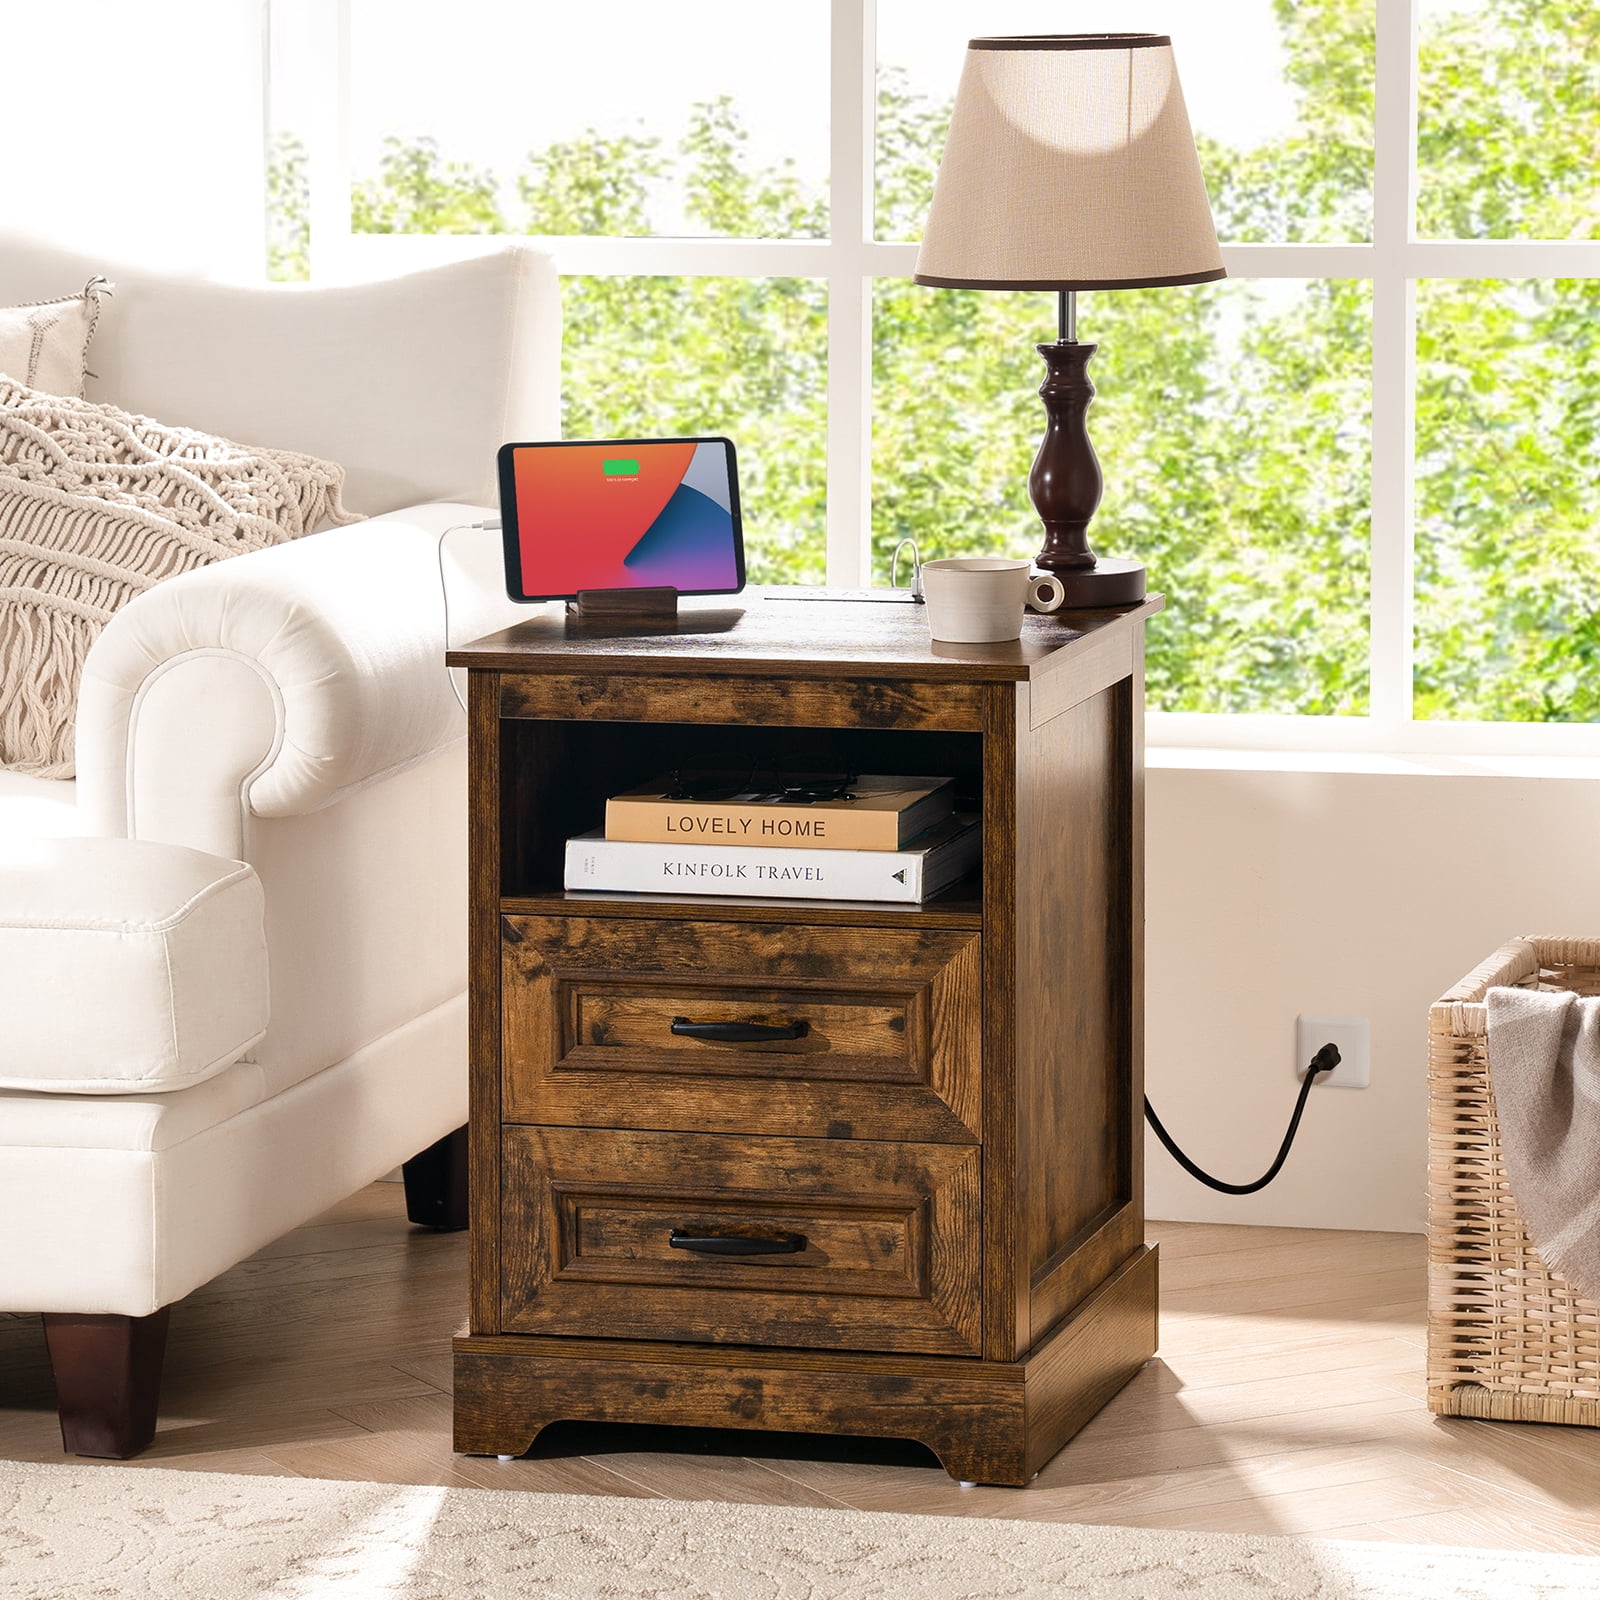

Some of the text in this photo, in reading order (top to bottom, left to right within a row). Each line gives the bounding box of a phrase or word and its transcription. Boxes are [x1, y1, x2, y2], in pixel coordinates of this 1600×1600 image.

[666, 815, 826, 837] LOVELY HOME
[663, 862, 824, 881] KINFOLK TRAVEL
